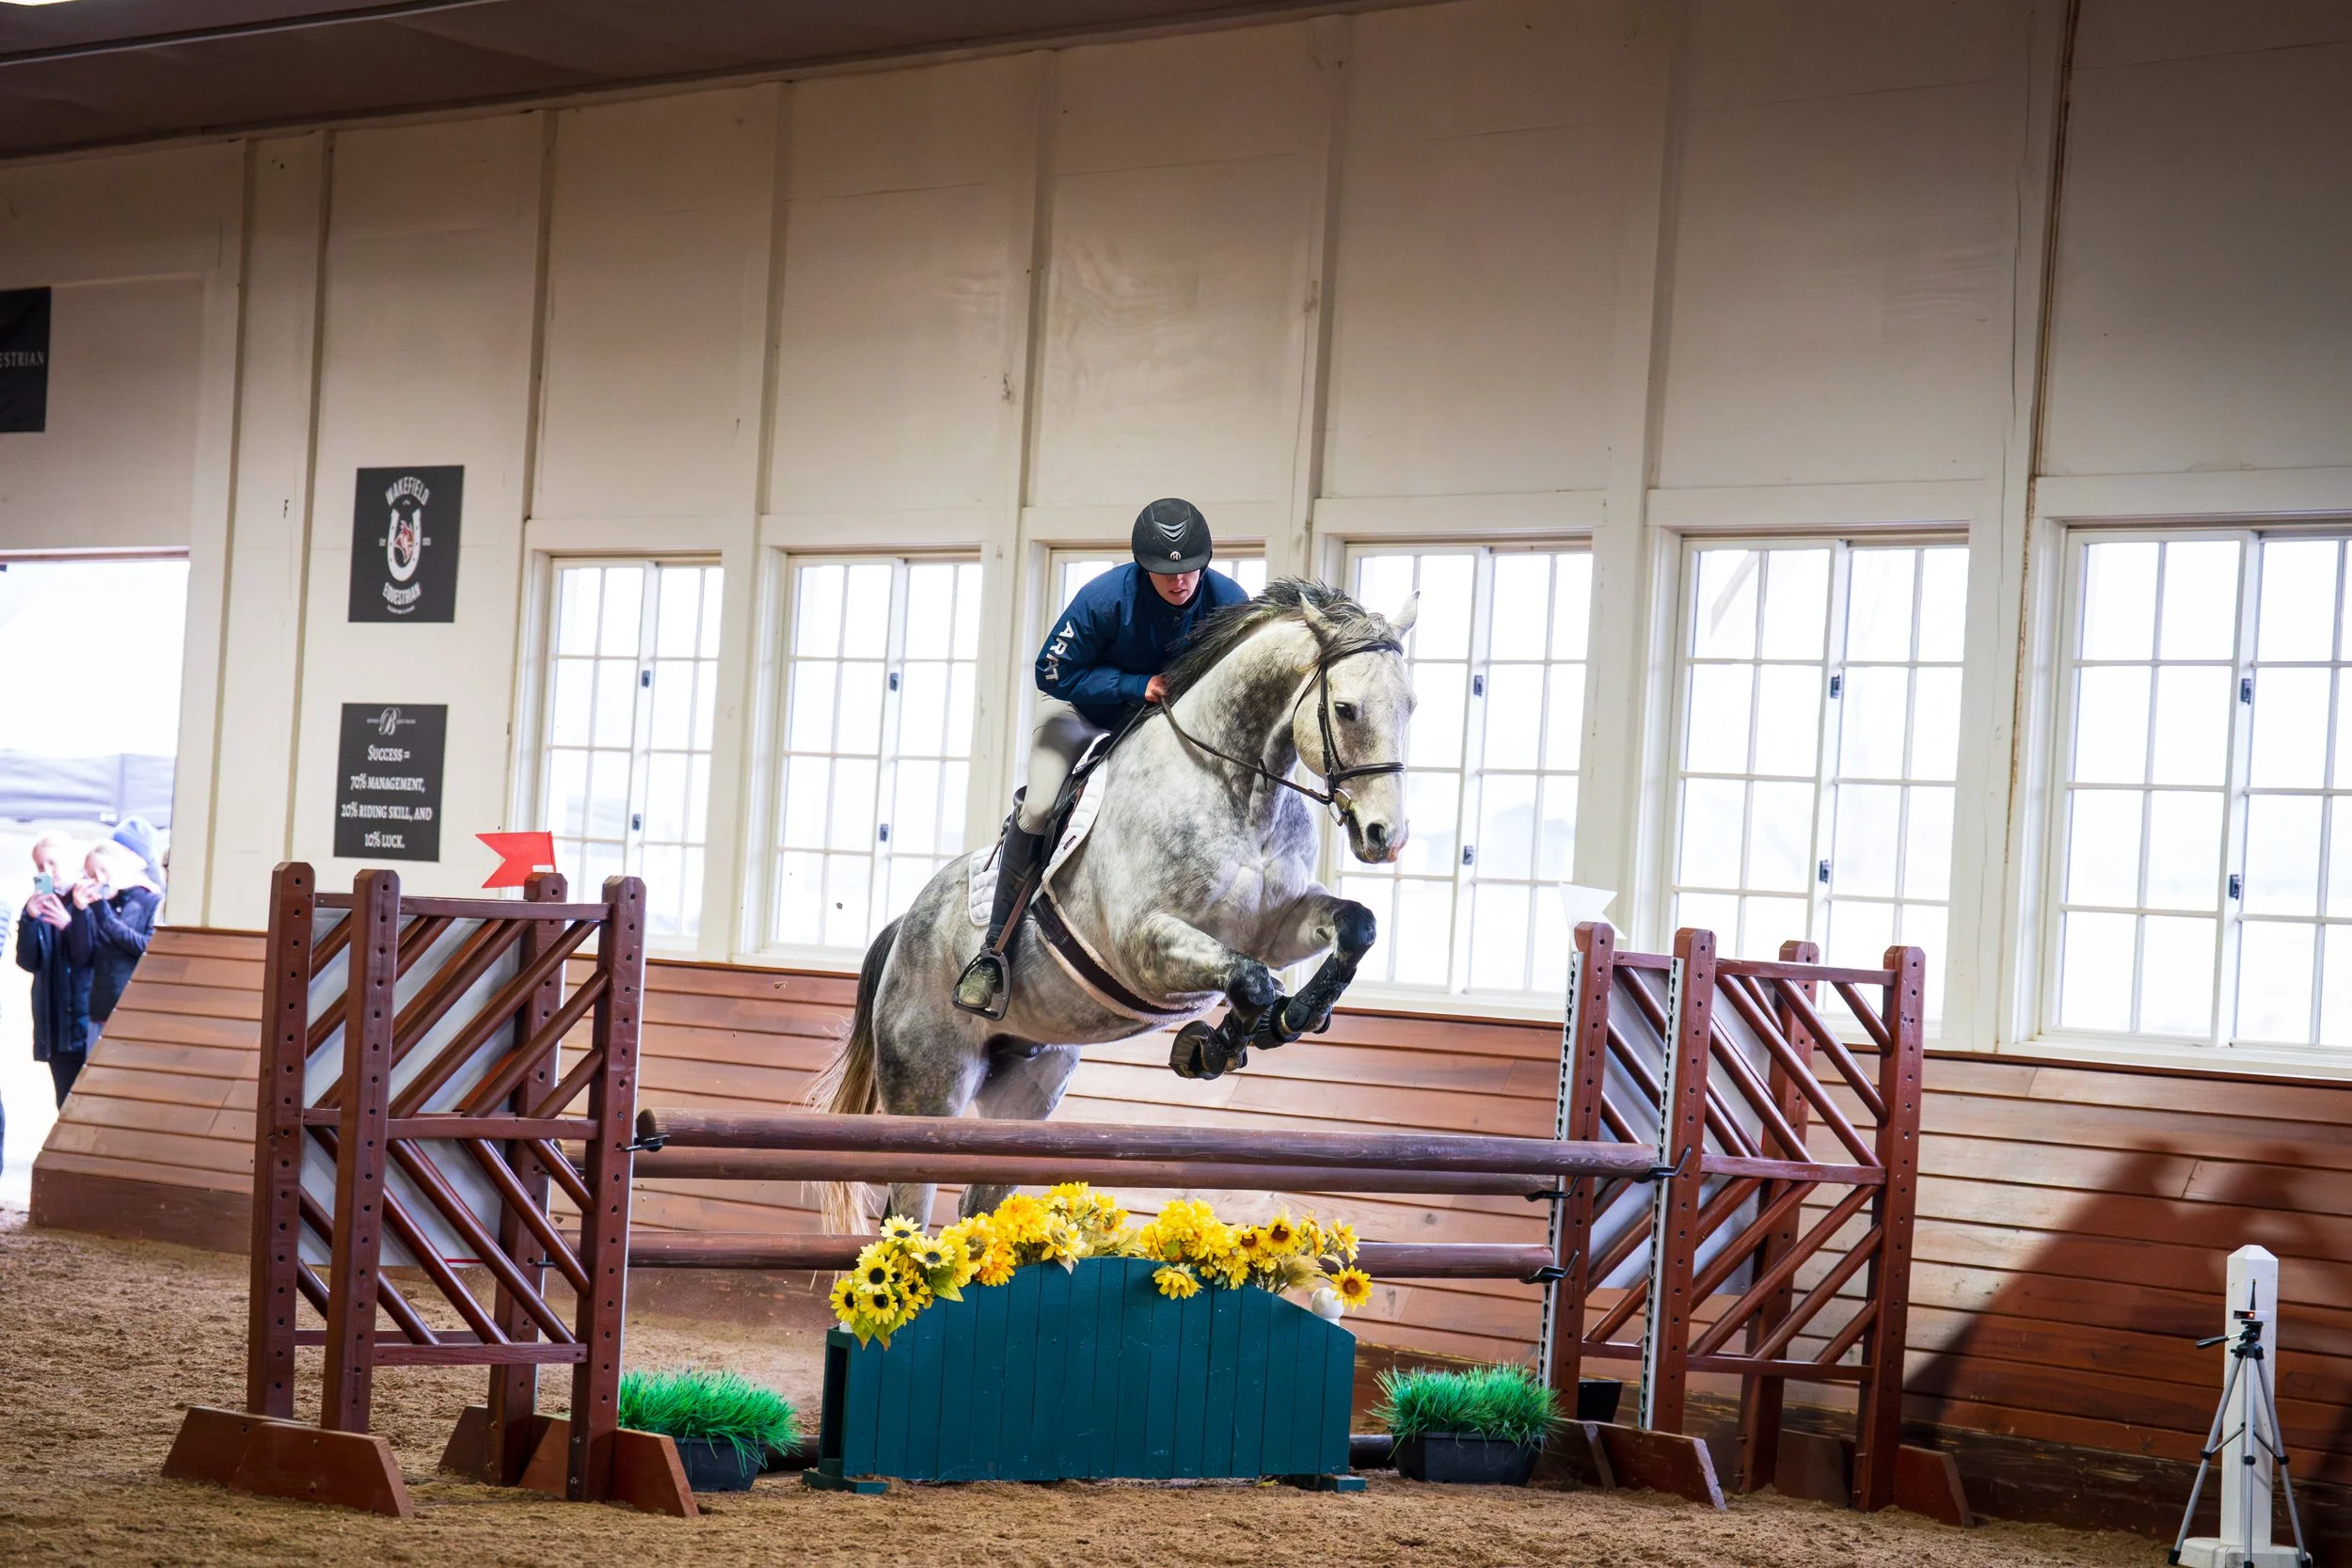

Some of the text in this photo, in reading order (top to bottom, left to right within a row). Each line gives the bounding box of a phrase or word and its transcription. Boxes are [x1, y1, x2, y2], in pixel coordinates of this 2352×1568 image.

[385, 476, 430, 506] WAKEFIELD
[382, 581, 421, 605] EQUESTRIAN
[350, 772, 425, 794] 70% MANAGEMENT,
[358, 804, 388, 818] RIDING
[388, 805, 413, 822] SKILL,
[413, 806, 433, 821] AND
[364, 831, 405, 848] 10% LUCK.
